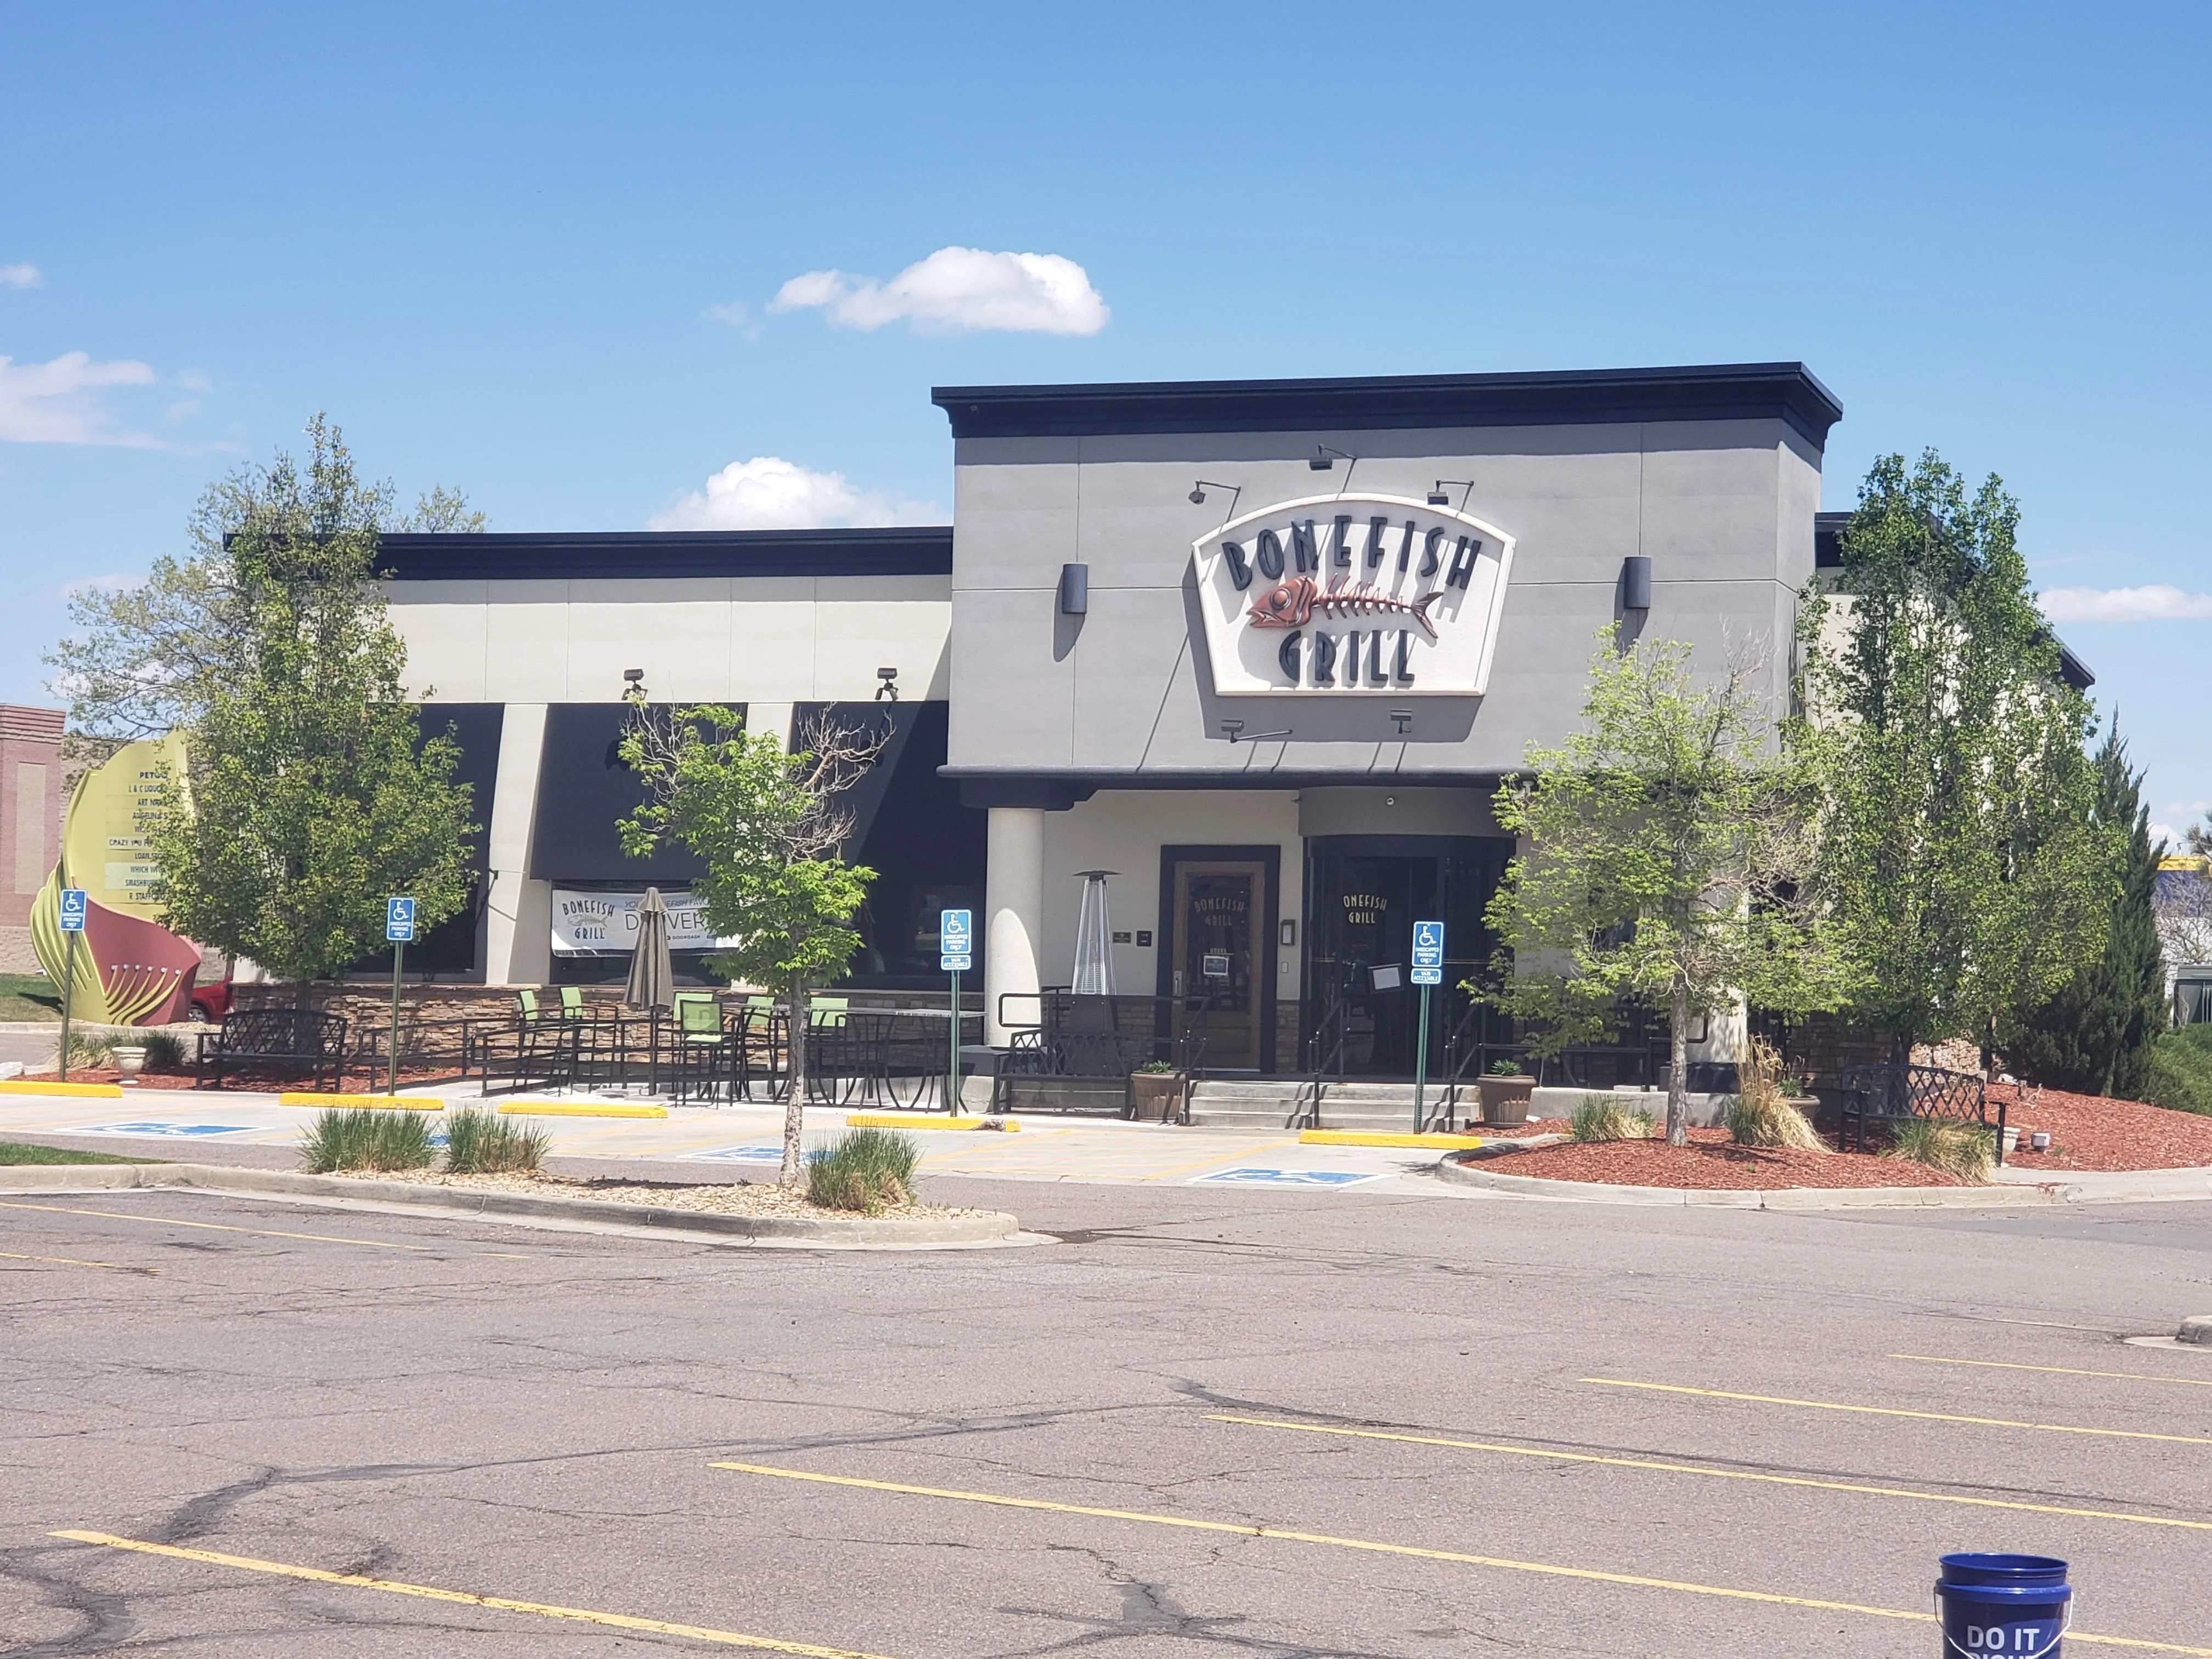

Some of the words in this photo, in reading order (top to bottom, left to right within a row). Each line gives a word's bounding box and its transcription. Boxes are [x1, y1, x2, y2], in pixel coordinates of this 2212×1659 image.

[1222, 516, 1482, 591] BONEFISH
[1279, 630, 1415, 682] GRILL
[562, 900, 614, 917] BONEFISH
[1194, 898, 1244, 913] BONEFISH
[1343, 895, 1387, 911] ONEFISH
[1205, 915, 1232, 926] GRILL
[1348, 912, 1375, 923] GRILL
[575, 927, 605, 939] GRILL
[1967, 1625, 2005, 1650] DO
[2015, 1628, 2040, 1651] IT
